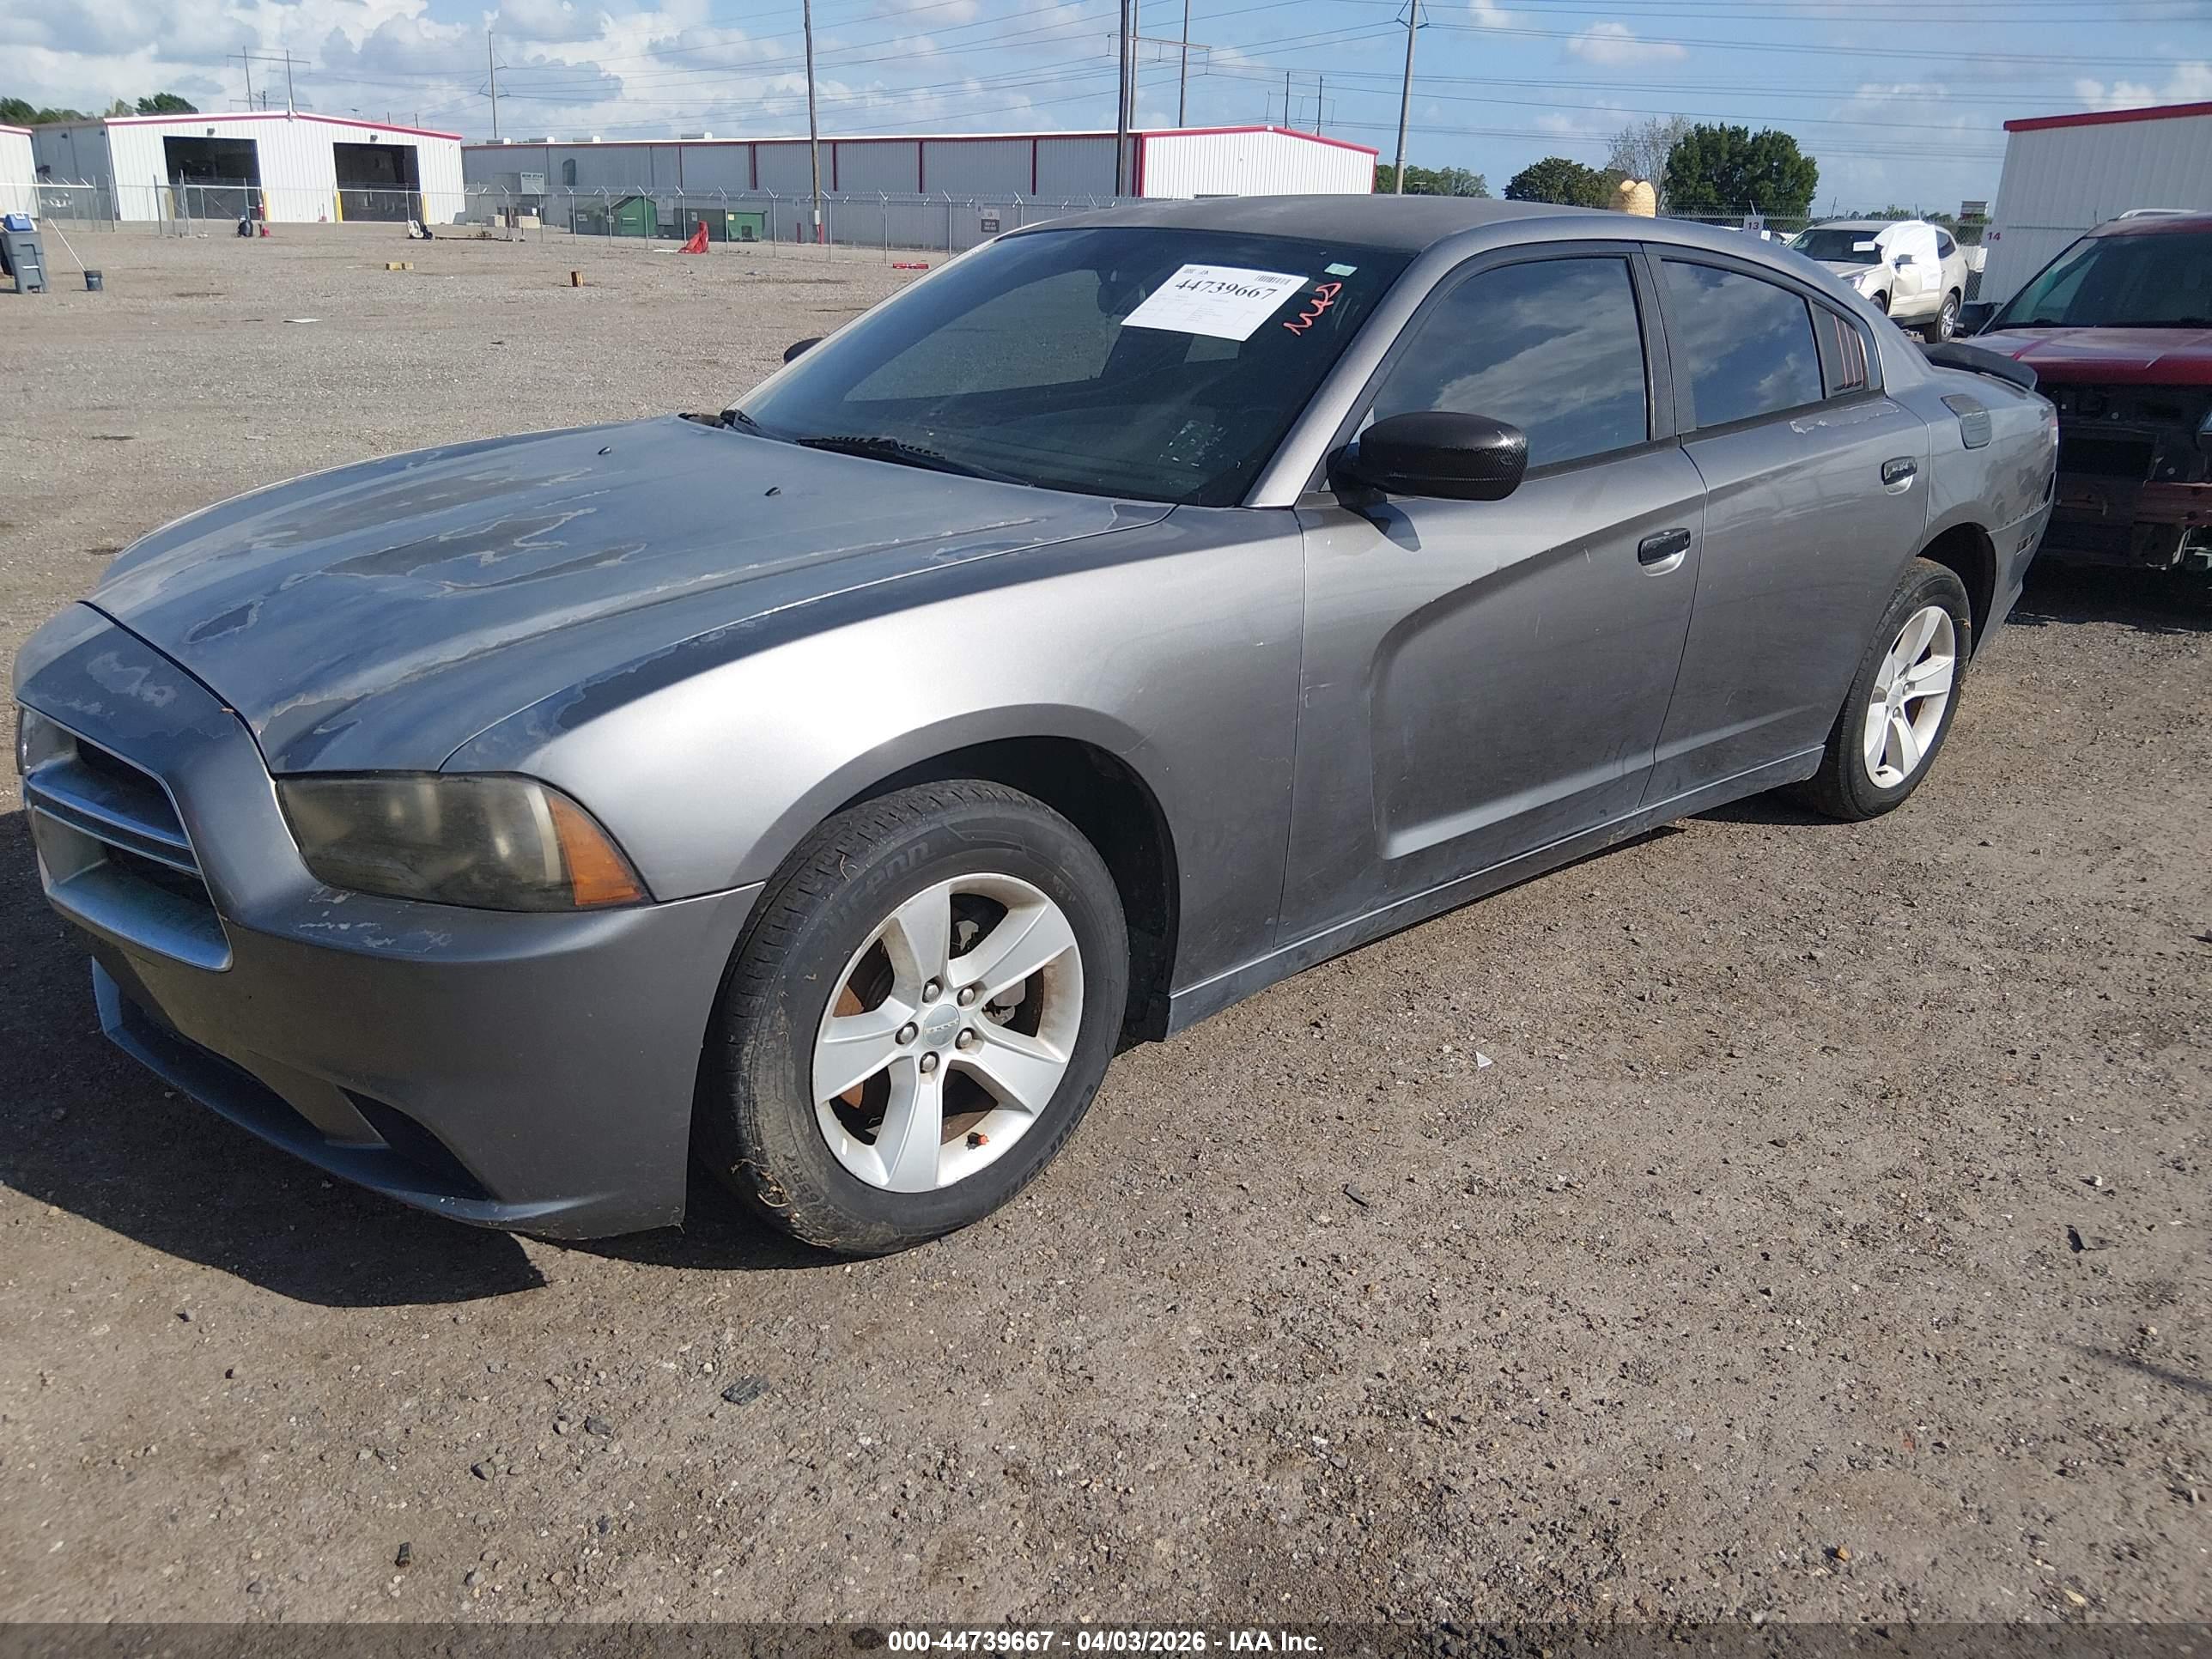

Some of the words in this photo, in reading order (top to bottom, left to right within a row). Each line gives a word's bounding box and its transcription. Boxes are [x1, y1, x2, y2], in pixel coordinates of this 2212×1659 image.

[1747, 222, 1759, 230] 13
[1987, 232, 2001, 240] 14
[1175, 278, 1277, 301] 44739667
